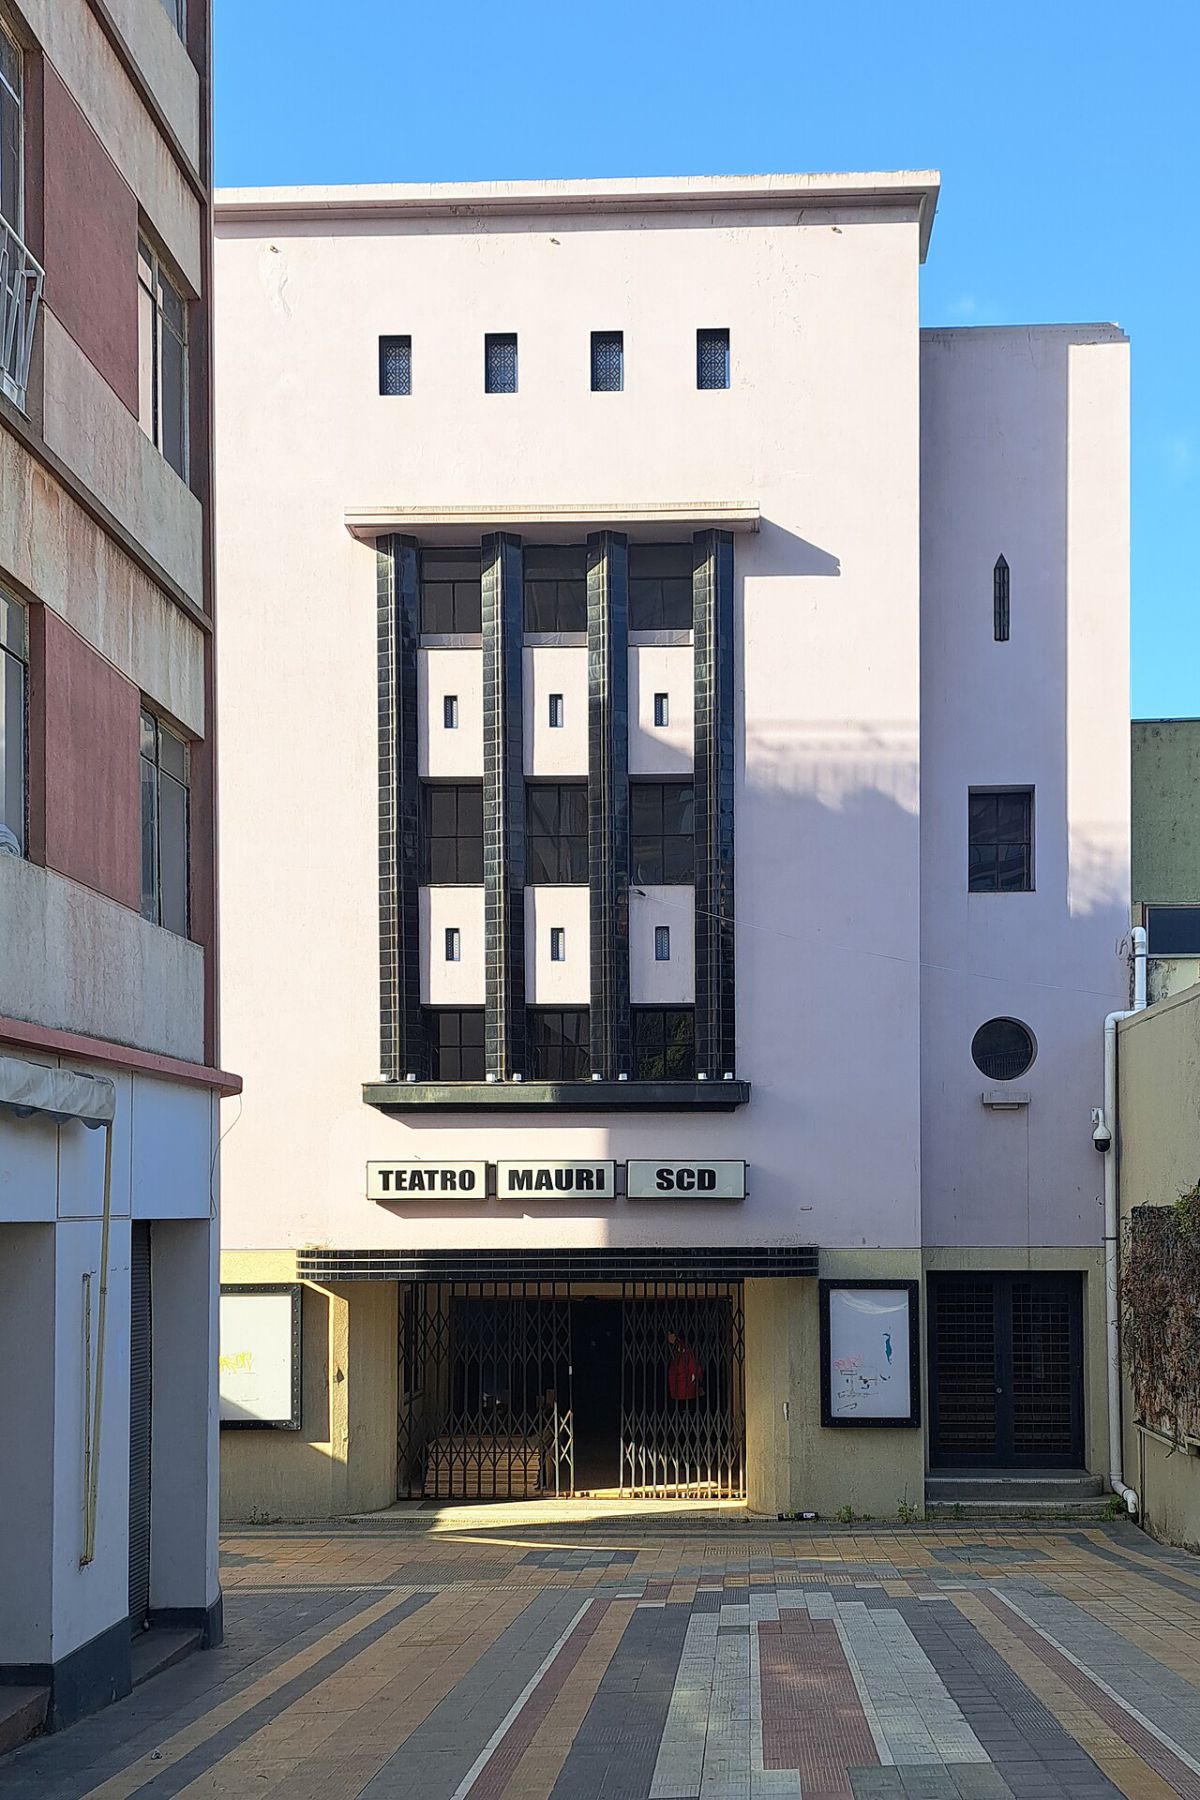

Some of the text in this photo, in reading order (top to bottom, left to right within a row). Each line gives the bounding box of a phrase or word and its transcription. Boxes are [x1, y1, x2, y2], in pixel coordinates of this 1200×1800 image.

[378, 1167, 717, 1192] TEATRO MAURI SCD
